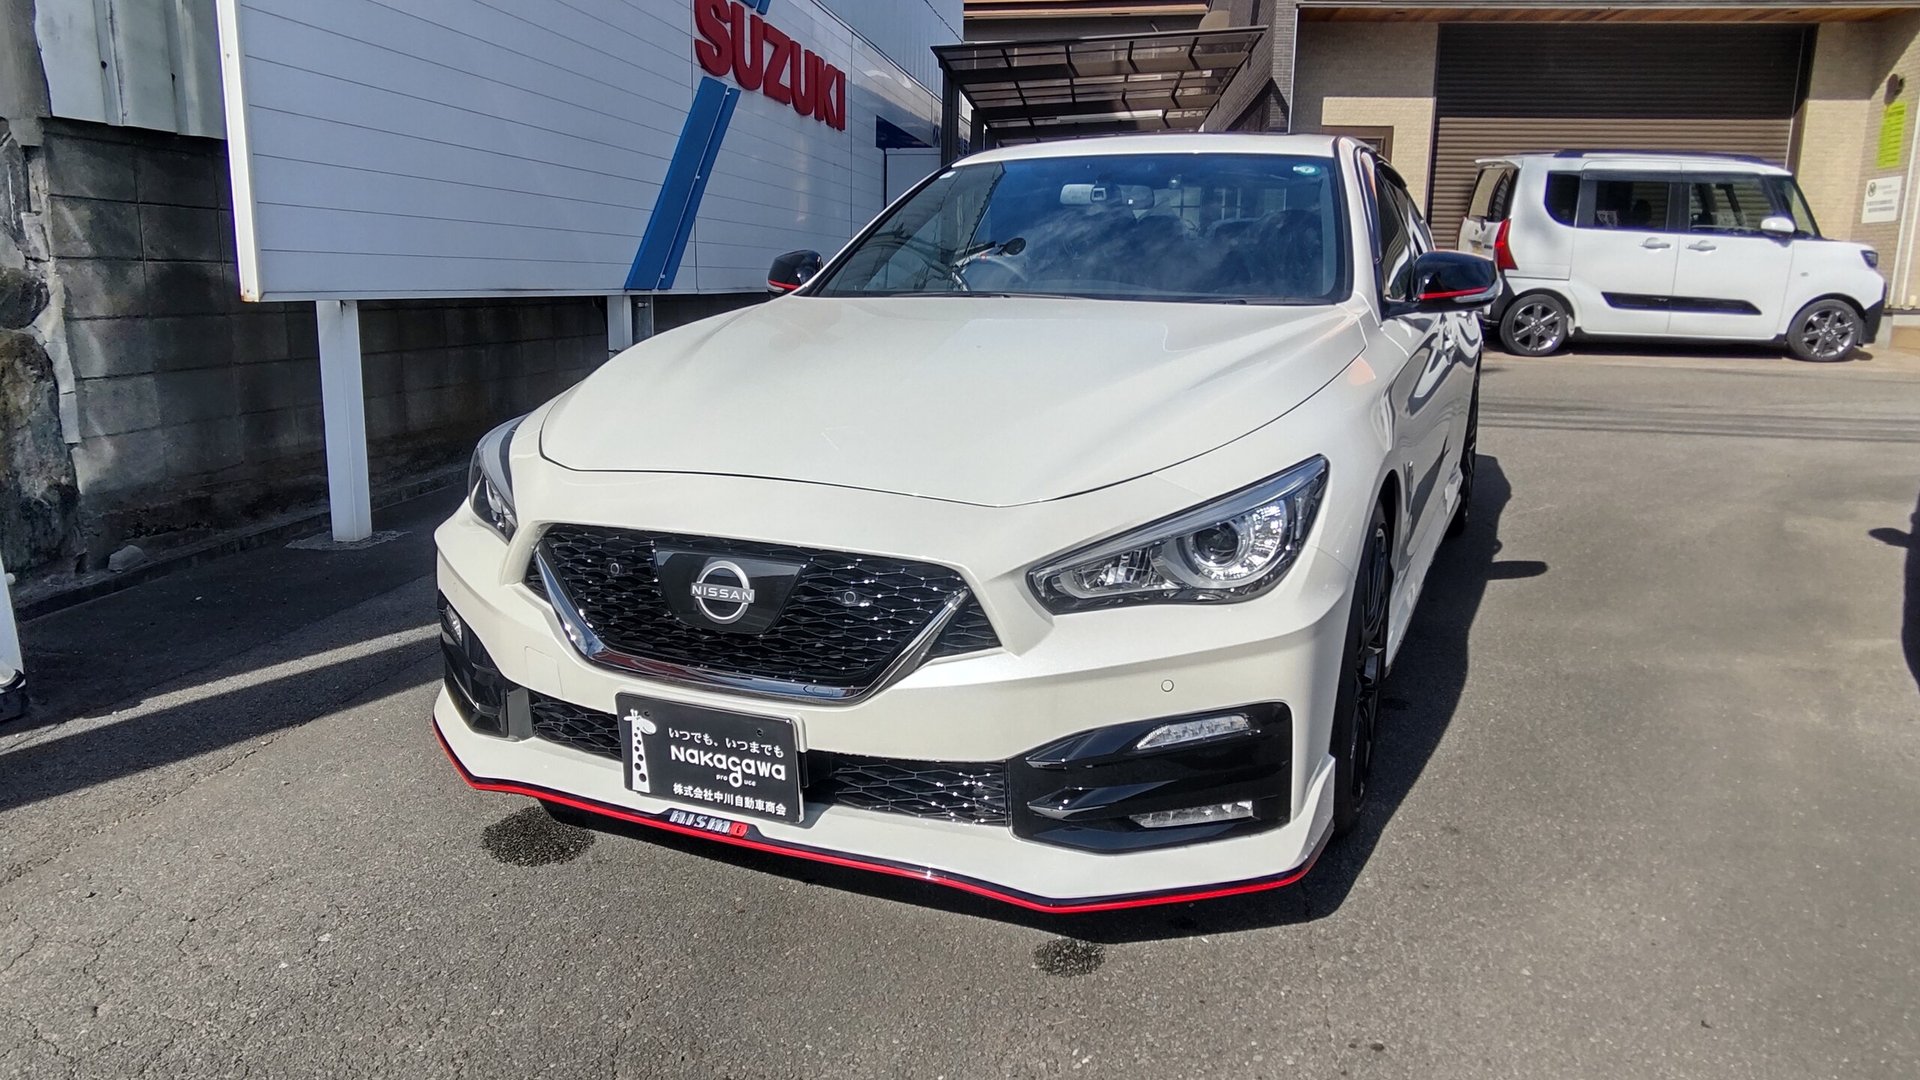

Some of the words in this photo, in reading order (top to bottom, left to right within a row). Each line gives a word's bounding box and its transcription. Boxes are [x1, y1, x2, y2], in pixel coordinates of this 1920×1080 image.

[694, 0, 846, 131] SUZUKI
[691, 585, 753, 601] NISSAN
[670, 745, 786, 784] Nakagawa
[673, 782, 787, 816] 株式会社中川自動車商会
